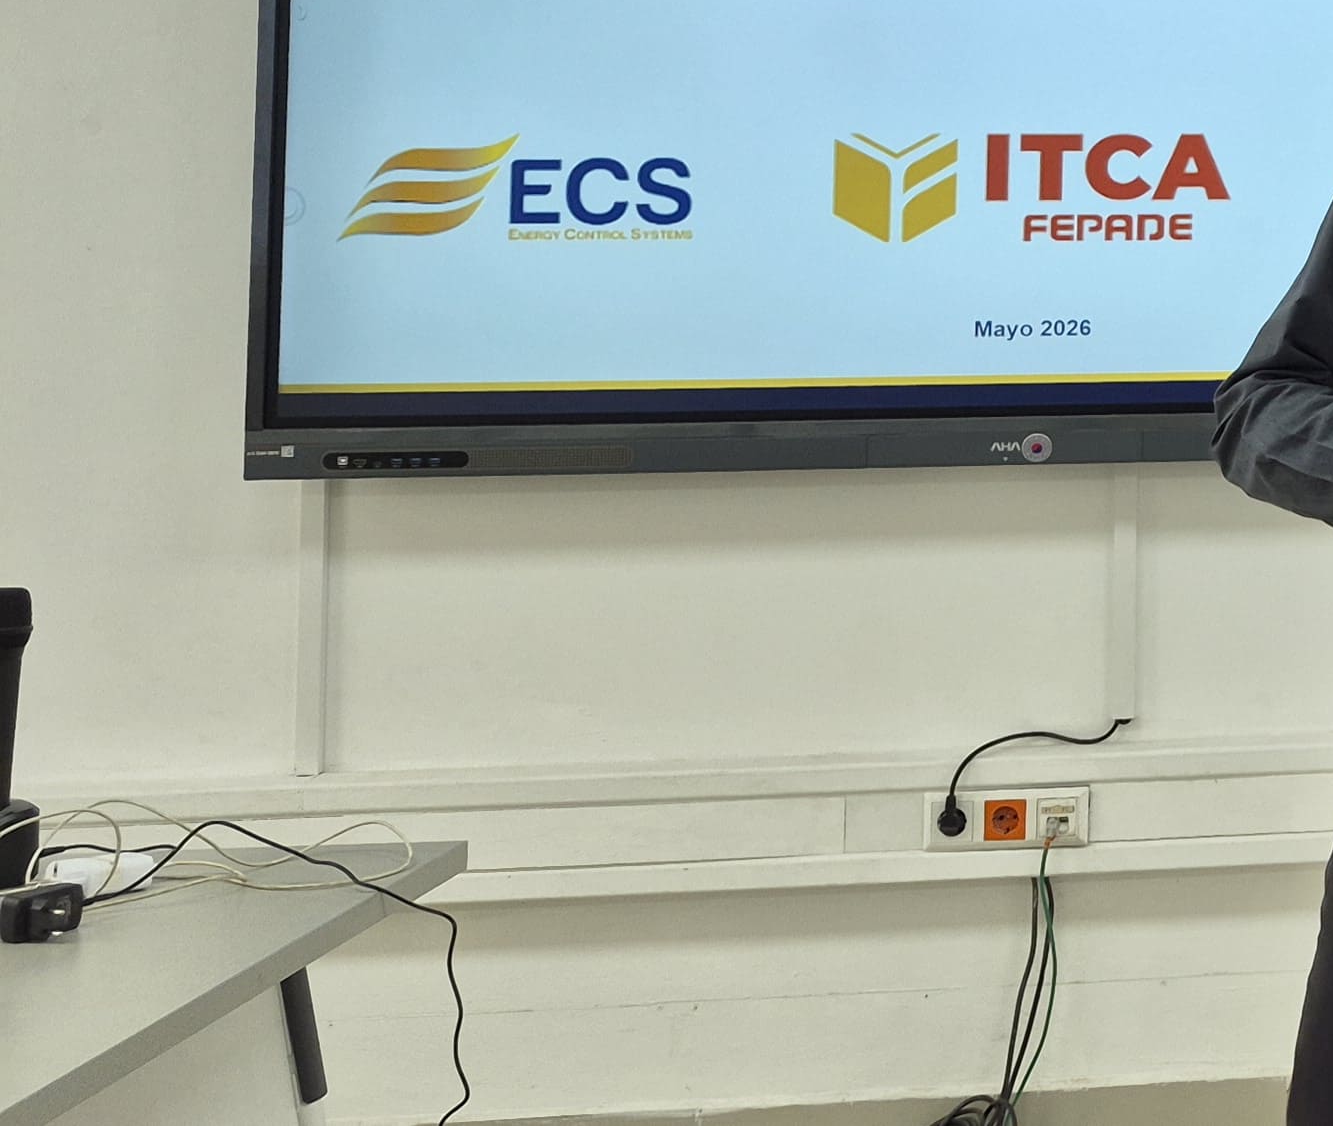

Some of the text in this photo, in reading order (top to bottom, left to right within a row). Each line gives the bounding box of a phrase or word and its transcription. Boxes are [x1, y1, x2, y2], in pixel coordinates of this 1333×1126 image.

[508, 157, 692, 225] ECS
[985, 133, 1231, 202] ITCA
[1022, 213, 1193, 242] FEPADE
[974, 319, 1092, 341] Mayo 2026
